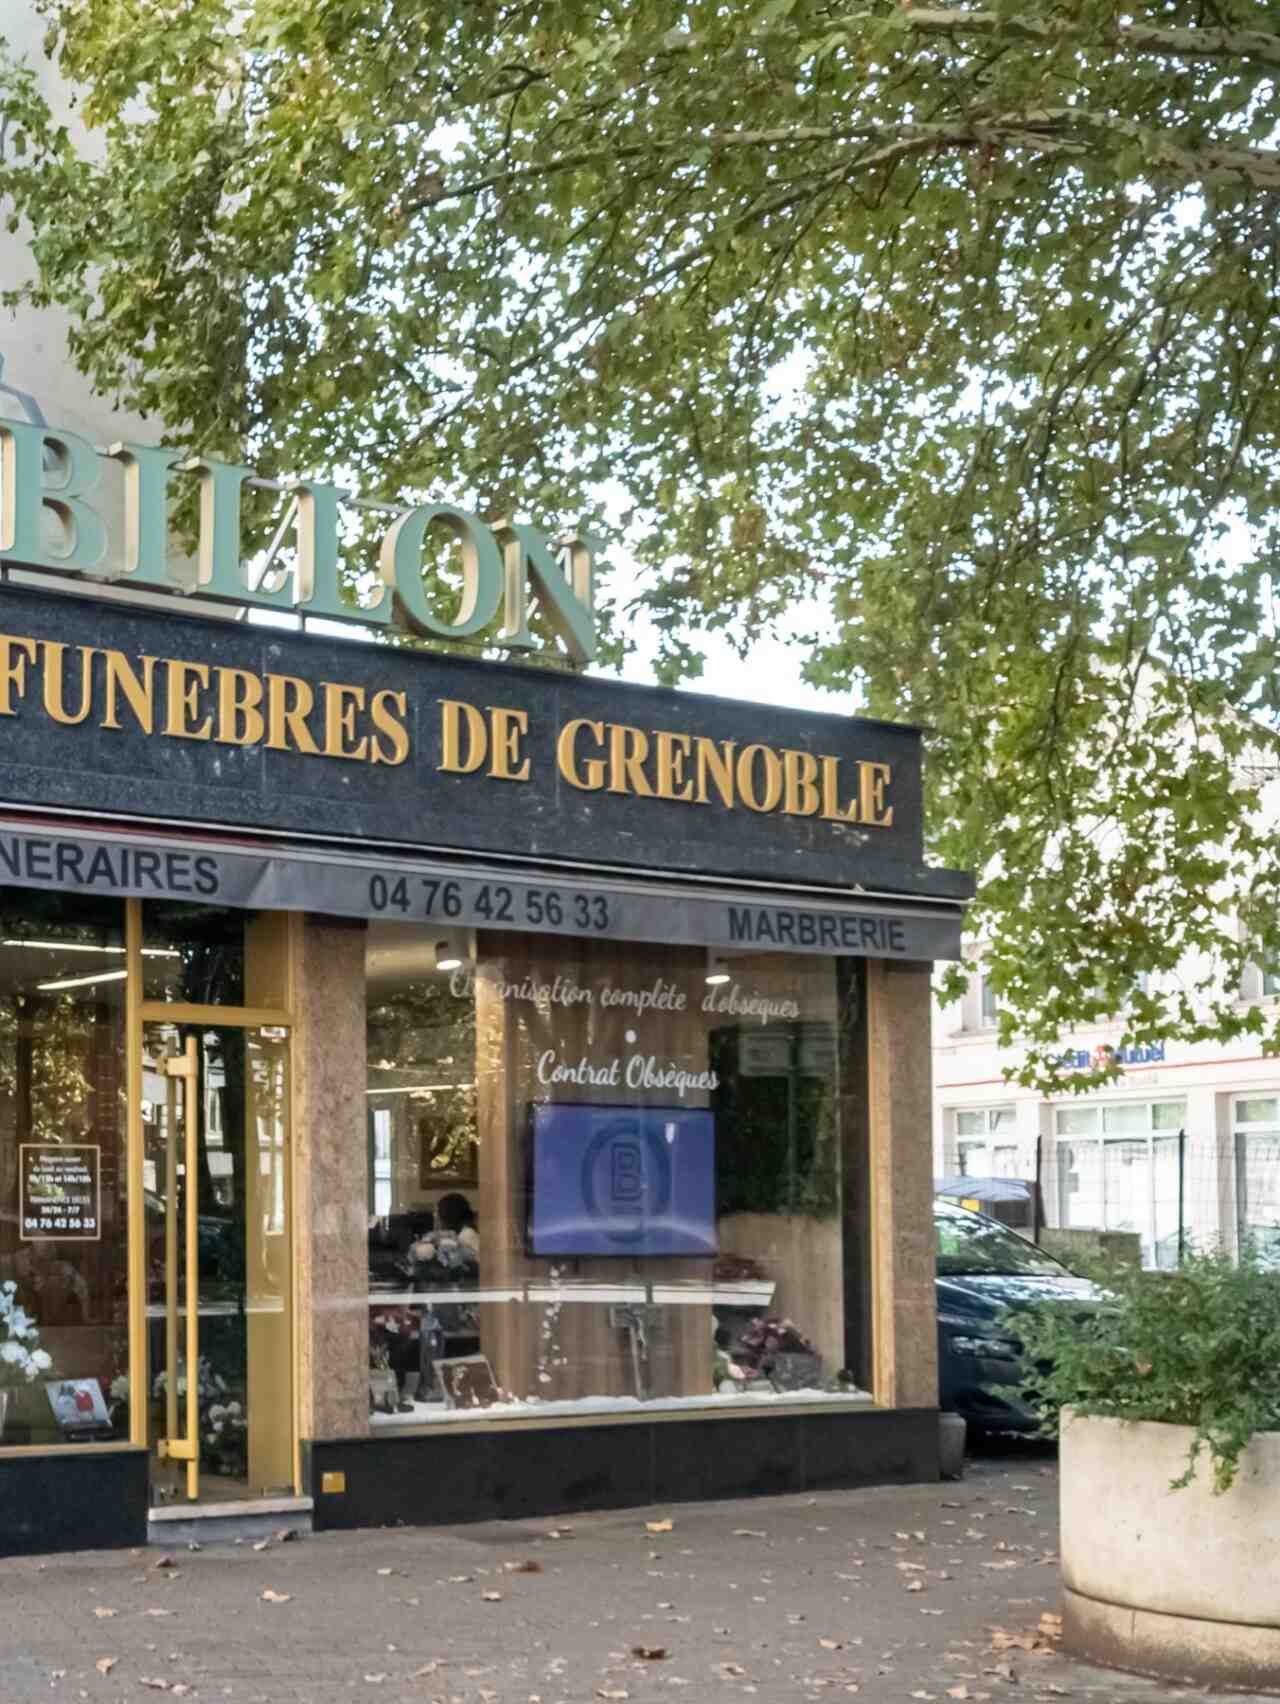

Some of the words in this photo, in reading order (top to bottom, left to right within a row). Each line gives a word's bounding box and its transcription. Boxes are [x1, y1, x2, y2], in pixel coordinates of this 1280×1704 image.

[436, 698, 531, 782] DE
[556, 718, 894, 828] GRENOBLE
[370, 874, 411, 912] 04
[422, 879, 462, 918] 76
[474, 885, 515, 922] 42
[526, 890, 563, 925] 56
[574, 894, 609, 930] 33
[728, 907, 907, 952] MARBRERIE
[601, 977, 687, 1017] complète
[536, 1050, 620, 1087] Contrat
[626, 1055, 720, 1097] Obsèques
